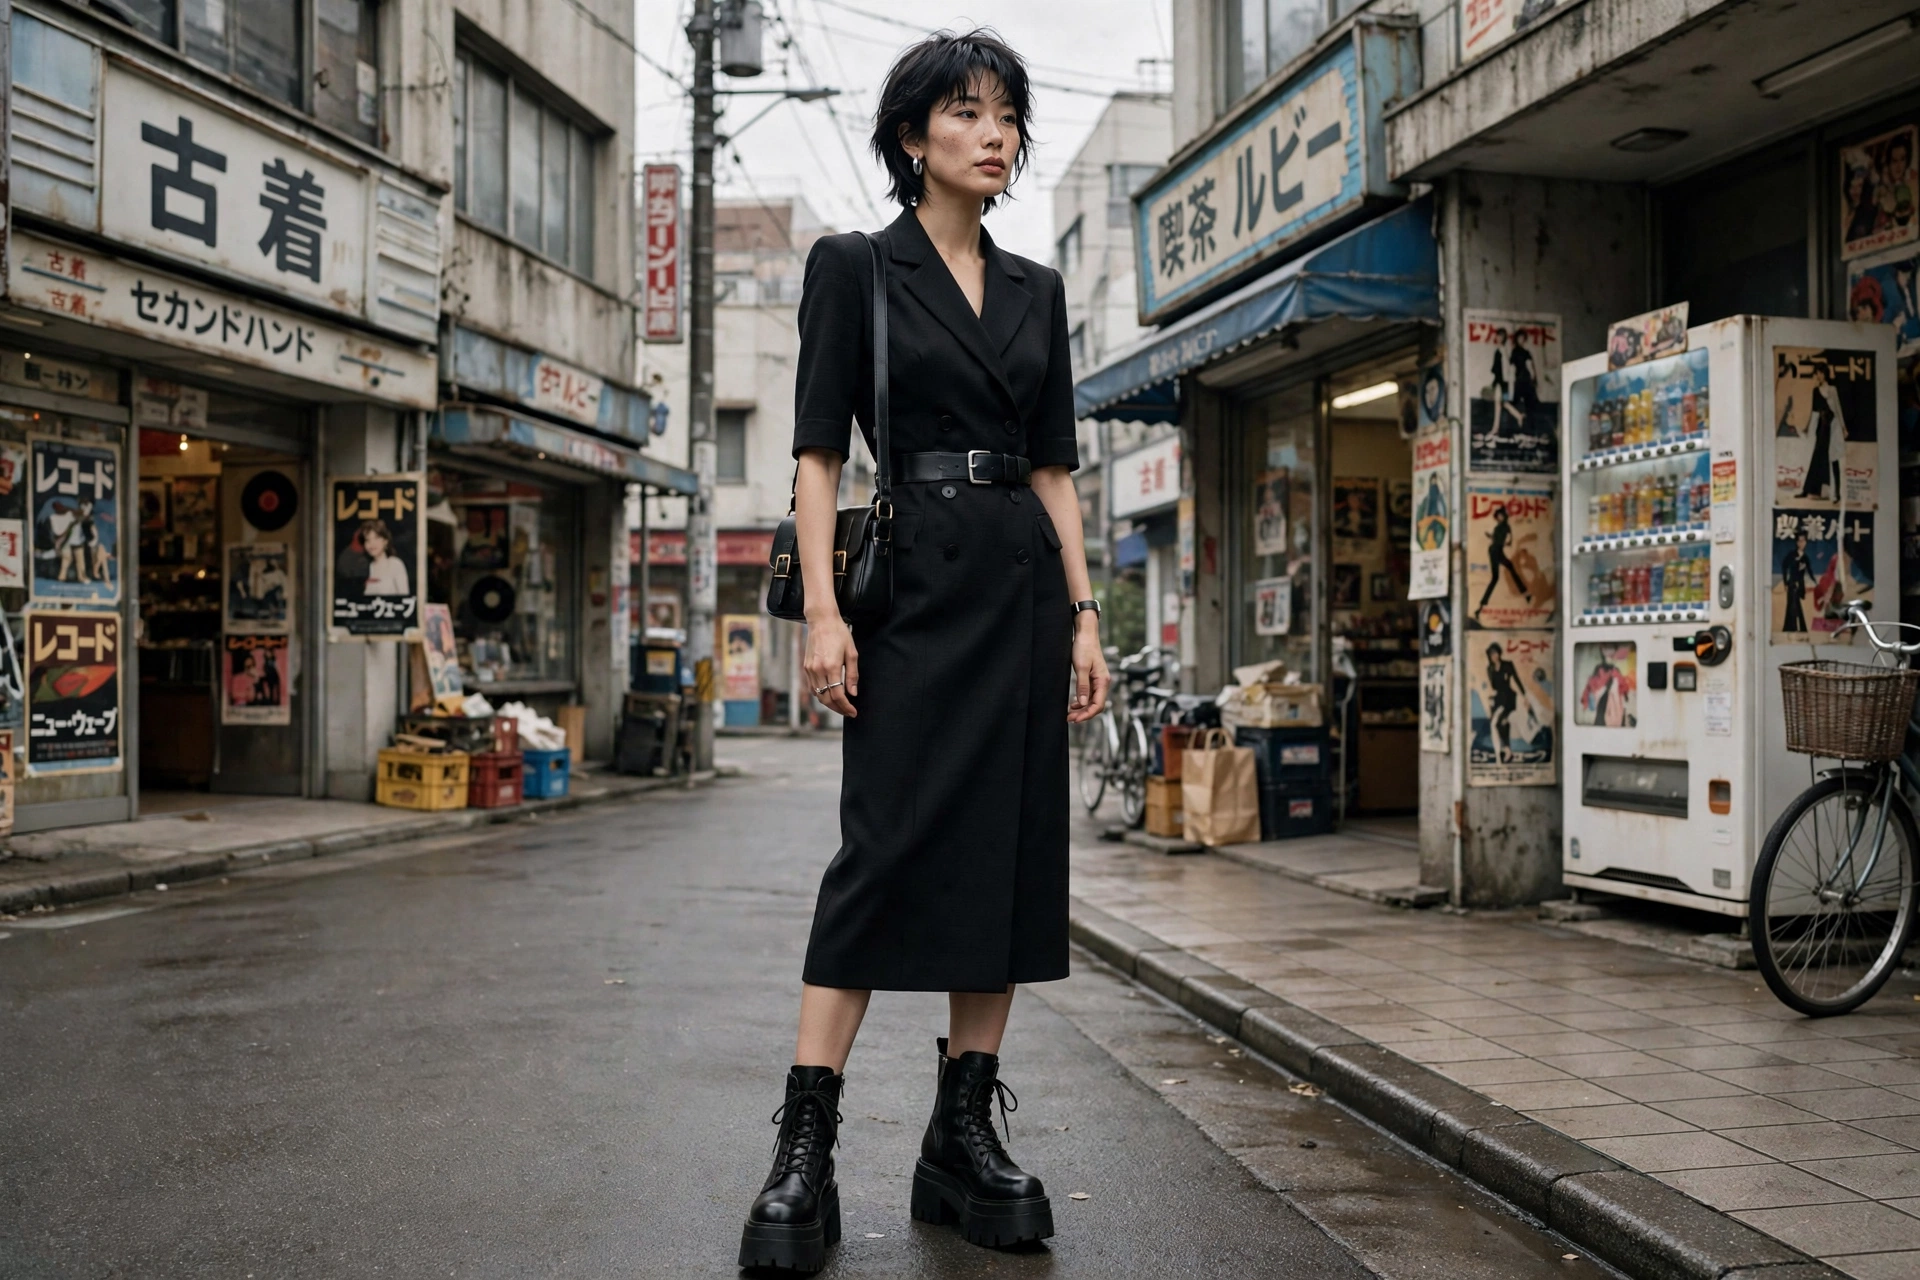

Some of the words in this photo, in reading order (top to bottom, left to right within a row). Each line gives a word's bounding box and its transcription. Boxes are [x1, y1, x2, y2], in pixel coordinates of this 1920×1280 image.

[141, 115, 327, 284] 古着
[1158, 177, 1217, 279] 喫茶
[1233, 105, 1341, 239] ルビー
[130, 279, 315, 362] セカンドハンド
[36, 452, 115, 501] レコード
[337, 487, 416, 522] レコード
[33, 621, 117, 662] レコード
